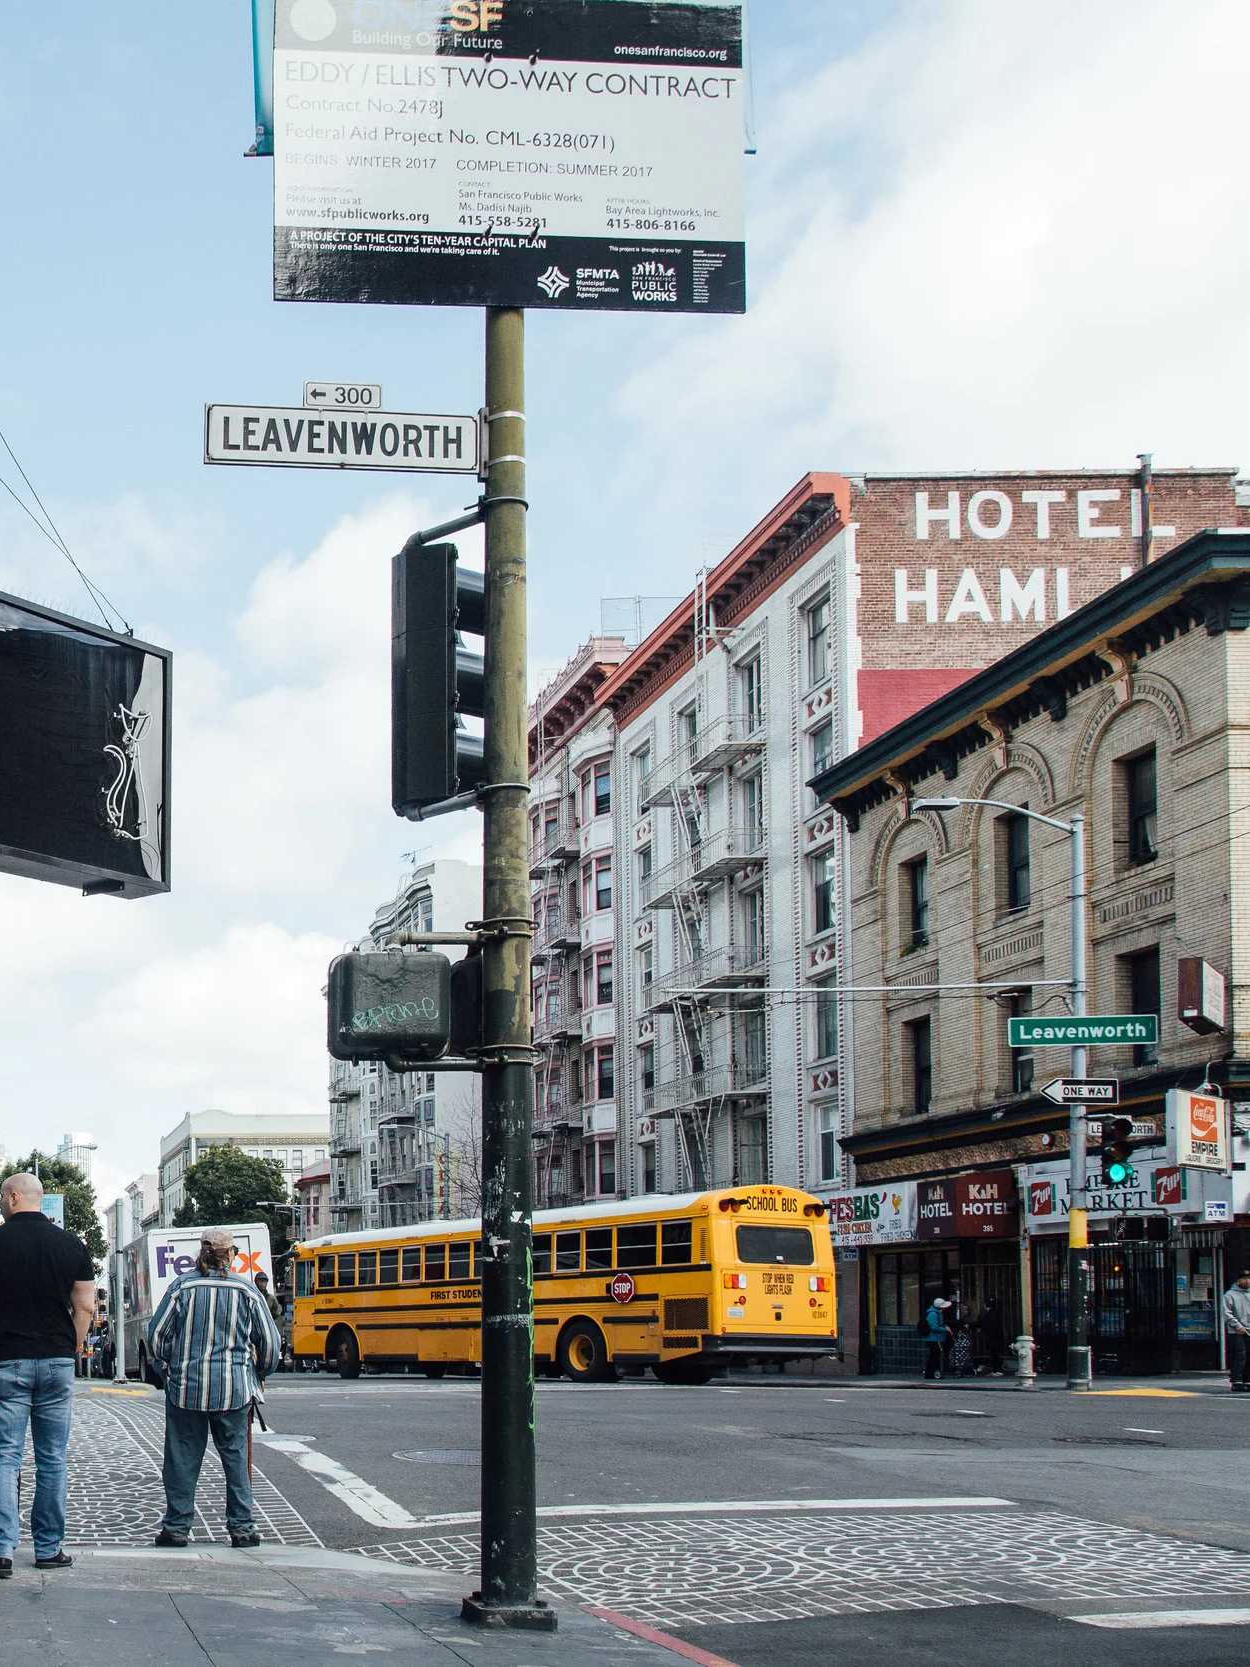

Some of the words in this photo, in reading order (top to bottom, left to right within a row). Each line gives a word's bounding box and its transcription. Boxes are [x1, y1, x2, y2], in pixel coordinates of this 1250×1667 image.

[353, 30, 411, 49] Building
[417, 32, 448, 48] Our
[453, 33, 503, 49] Future
[614, 45, 727, 61] onesanfrancisco.org
[285, 61, 355, 84] EDDY
[376, 65, 436, 87] ELLIS
[441, 66, 578, 93] TWO-WAY
[585, 73, 737, 99] CONTRACT
[286, 94, 361, 113] Contract
[367, 98, 443, 119] No.2478J
[286, 123, 345, 140] Federal
[350, 126, 378, 141] Aid
[384, 127, 443, 145] Project
[449, 129, 479, 145] No.
[486, 131, 615, 153] CML-6328(071)
[346, 155, 401, 169] WINTER
[405, 157, 436, 169] 2017
[456, 159, 552, 175] COMPLETION:
[557, 163, 619, 177] SUMMER
[622, 166, 654, 178] 2017
[286, 194, 317, 205] Please
[318, 194, 337, 205] visit
[339, 197, 350, 205] us
[352, 197, 361, 205] at
[459, 189, 476, 199] San
[478, 190, 521, 201] Francisco
[523, 192, 552, 202] Public
[554, 193, 583, 203] Works
[286, 207, 429, 224] www.sfpublicworks.org
[459, 202, 475, 211] Ms.
[477, 203, 505, 213] Dadisi
[508, 204, 532, 215] Najib
[606, 206, 623, 217] Bay
[625, 207, 646, 216] Area
[649, 208, 702, 219] Lightworks,
[704, 209, 721, 218] Inc.
[459, 215, 547, 230] 415-558-5281
[606, 218, 695, 231] 415-806-8166
[291, 231, 298, 240] A
[300, 231, 345, 242] PROJECT
[348, 233, 362, 243] OF
[364, 233, 385, 244] THE
[387, 233, 419, 245] CITY'S
[421, 235, 472, 247] TEN-YEAR
[474, 237, 516, 248] CAPITAL
[519, 238, 547, 249] PLAN
[291, 242, 310, 250] There
[312, 242, 319, 250] is
[320, 243, 336, 252] only
[354, 243, 367, 252] San
[369, 244, 403, 253] Francisco
[405, 245, 418, 253] and
[441, 246, 464, 256] taking
[483, 247, 491, 255] of
[576, 268, 620, 280] SFMTA
[576, 280, 605, 288] Municipal
[576, 286, 620, 294] Transportation
[632, 281, 677, 291] PUBLIC
[632, 291, 678, 302] WORKS
[334, 387, 372, 405] 300
[222, 416, 462, 459] LEAVENWORTH
[915, 488, 1176, 540] HOTEL
[1020, 1023, 1146, 1039] Leavenworth
[1063, 1086, 1084, 1096] ONE
[1087, 1086, 1109, 1096] WAY
[1191, 1141, 1218, 1156] EMPIRE
[747, 1196, 778, 1212] SCHOOL
[781, 1198, 798, 1213] BUS
[920, 1202, 953, 1219] HOTEL
[961, 1202, 1012, 1216] HOTEL
[1207, 1209, 1226, 1217] ATM
[762, 1273, 772, 1284] STOP
[773, 1273, 785, 1284] WHEN
[786, 1274, 794, 1284] RED
[430, 1290, 450, 1300] FIRST
[614, 1282, 631, 1294] STOP
[764, 1284, 778, 1295] LIGHTS
[779, 1285, 792, 1296] FLASH
